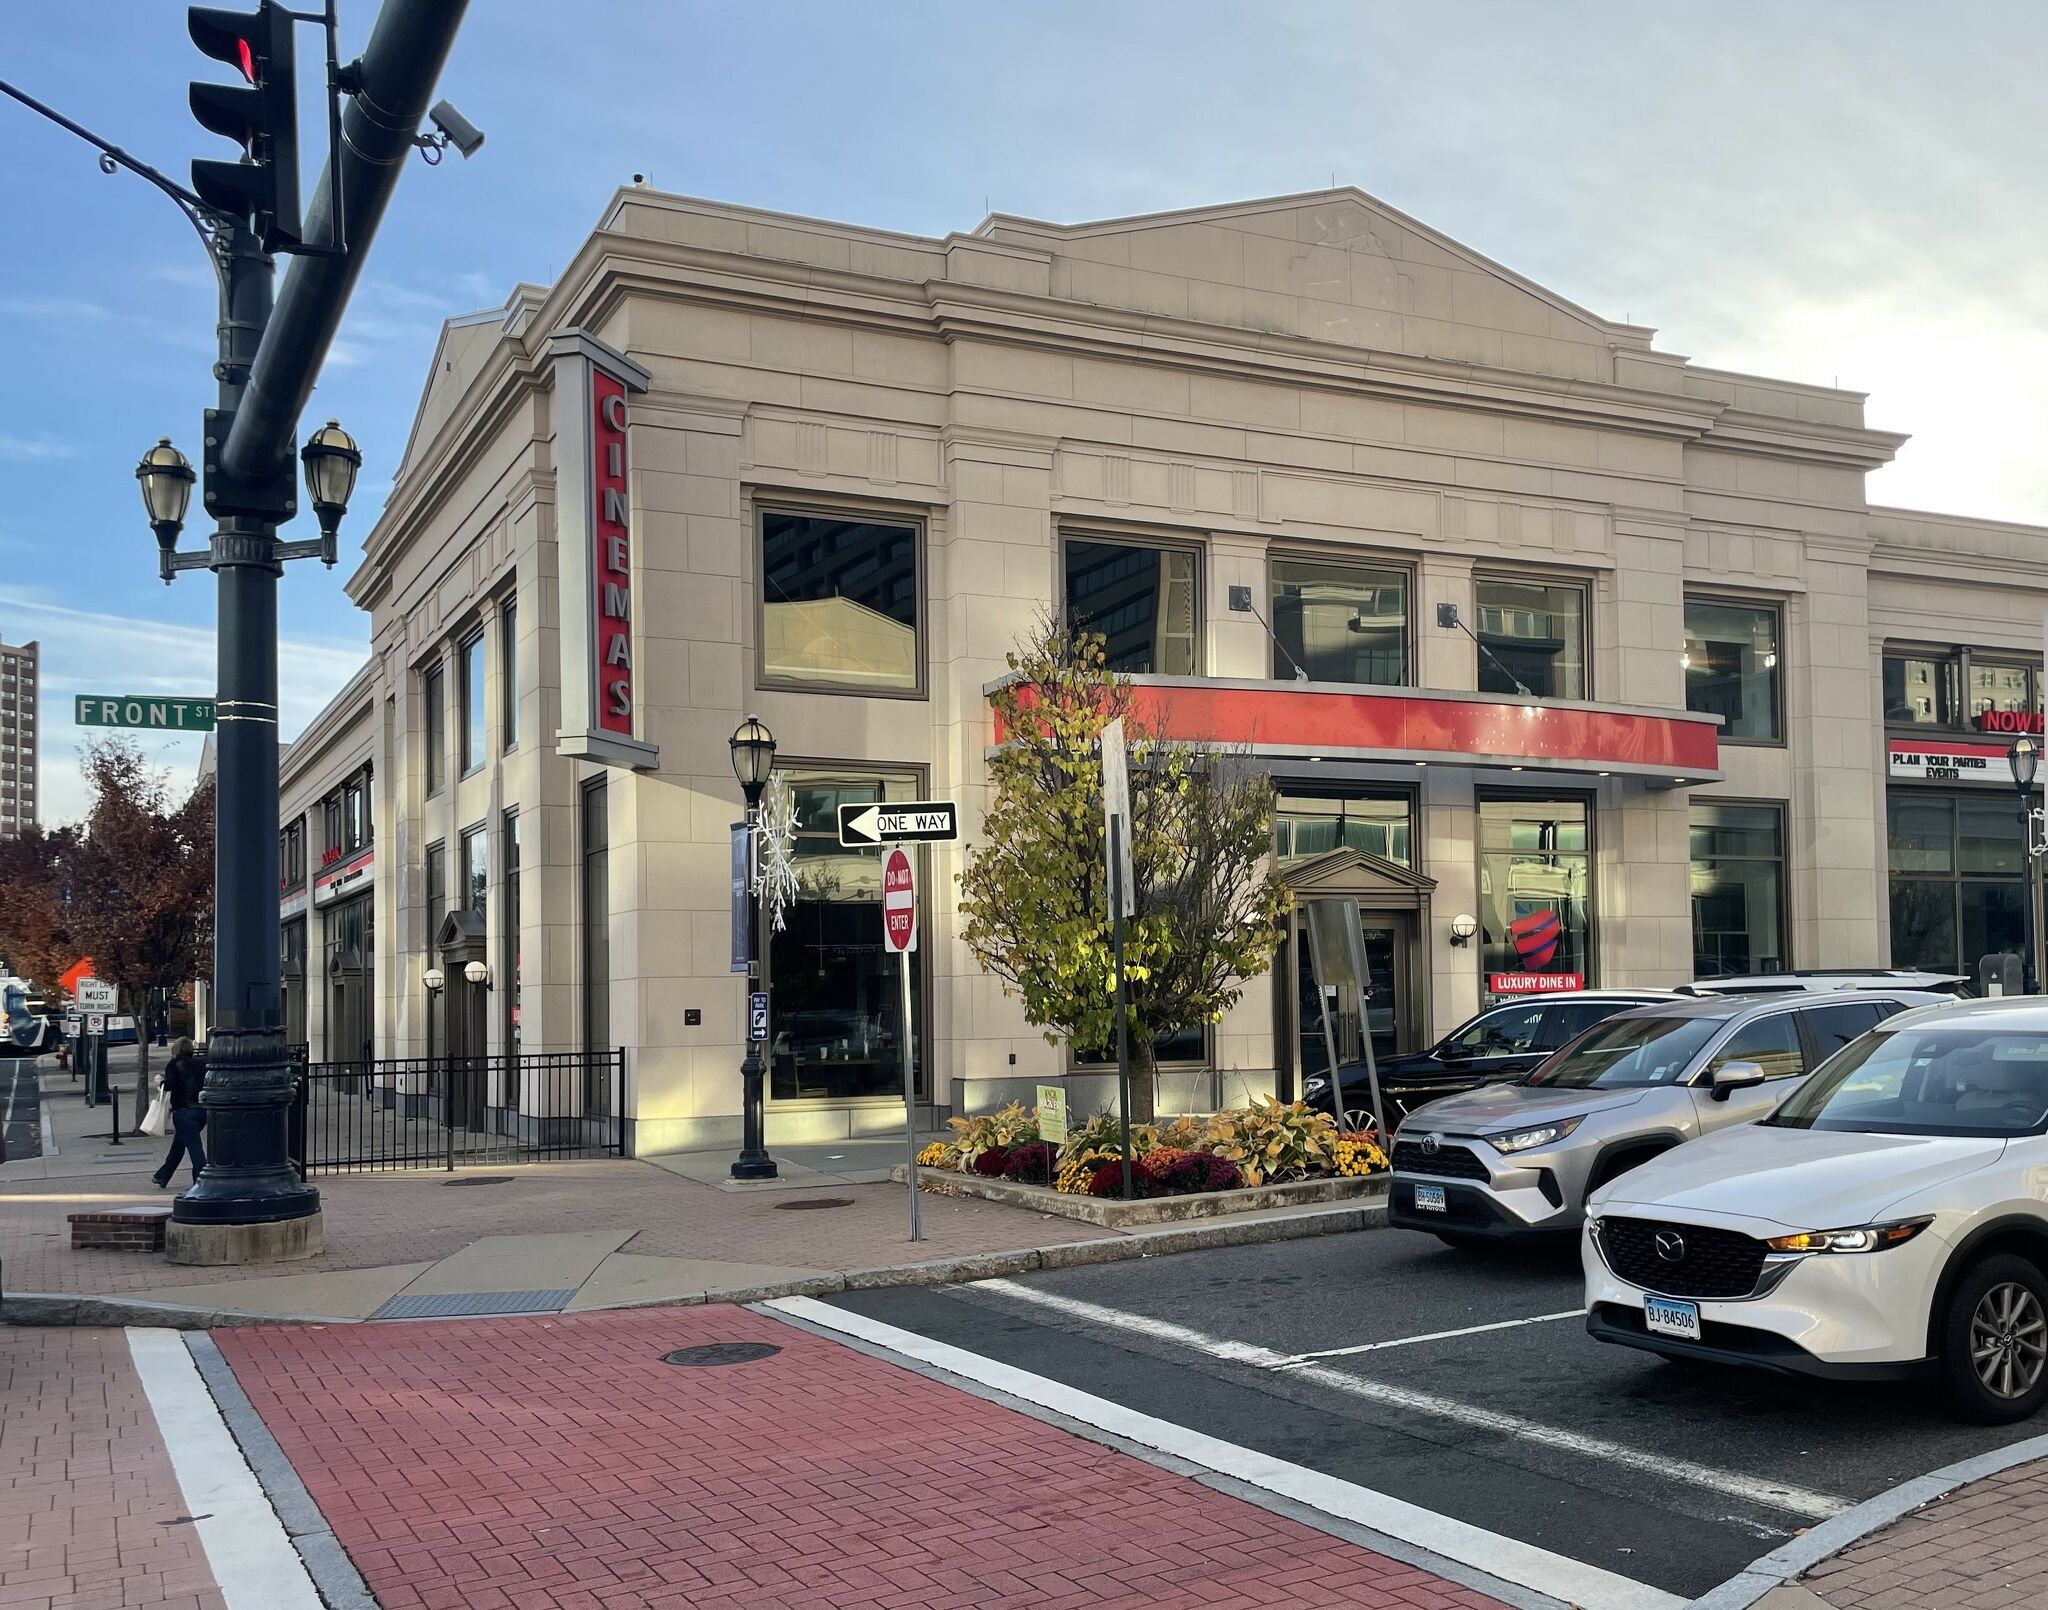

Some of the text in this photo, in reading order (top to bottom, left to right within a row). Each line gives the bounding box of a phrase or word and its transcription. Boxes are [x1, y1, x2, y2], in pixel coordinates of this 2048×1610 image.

[602, 394, 632, 717] CINEMAS
[80, 700, 211, 727] FRONT ST
[1987, 711, 2031, 732] NOW
[1893, 754, 1986, 769] PLAN YOUR PARTIES
[1926, 767, 1959, 779] EVENTS
[877, 814, 948, 832] ONE WAY
[887, 868, 910, 886] DO NOT
[891, 914, 909, 931] ENTER
[100, 981, 115, 989] LAN
[1498, 976, 1576, 989] LUXURY DINE IN
[85, 991, 109, 1001] MUST
[96, 1003, 115, 1011] RIGHT
